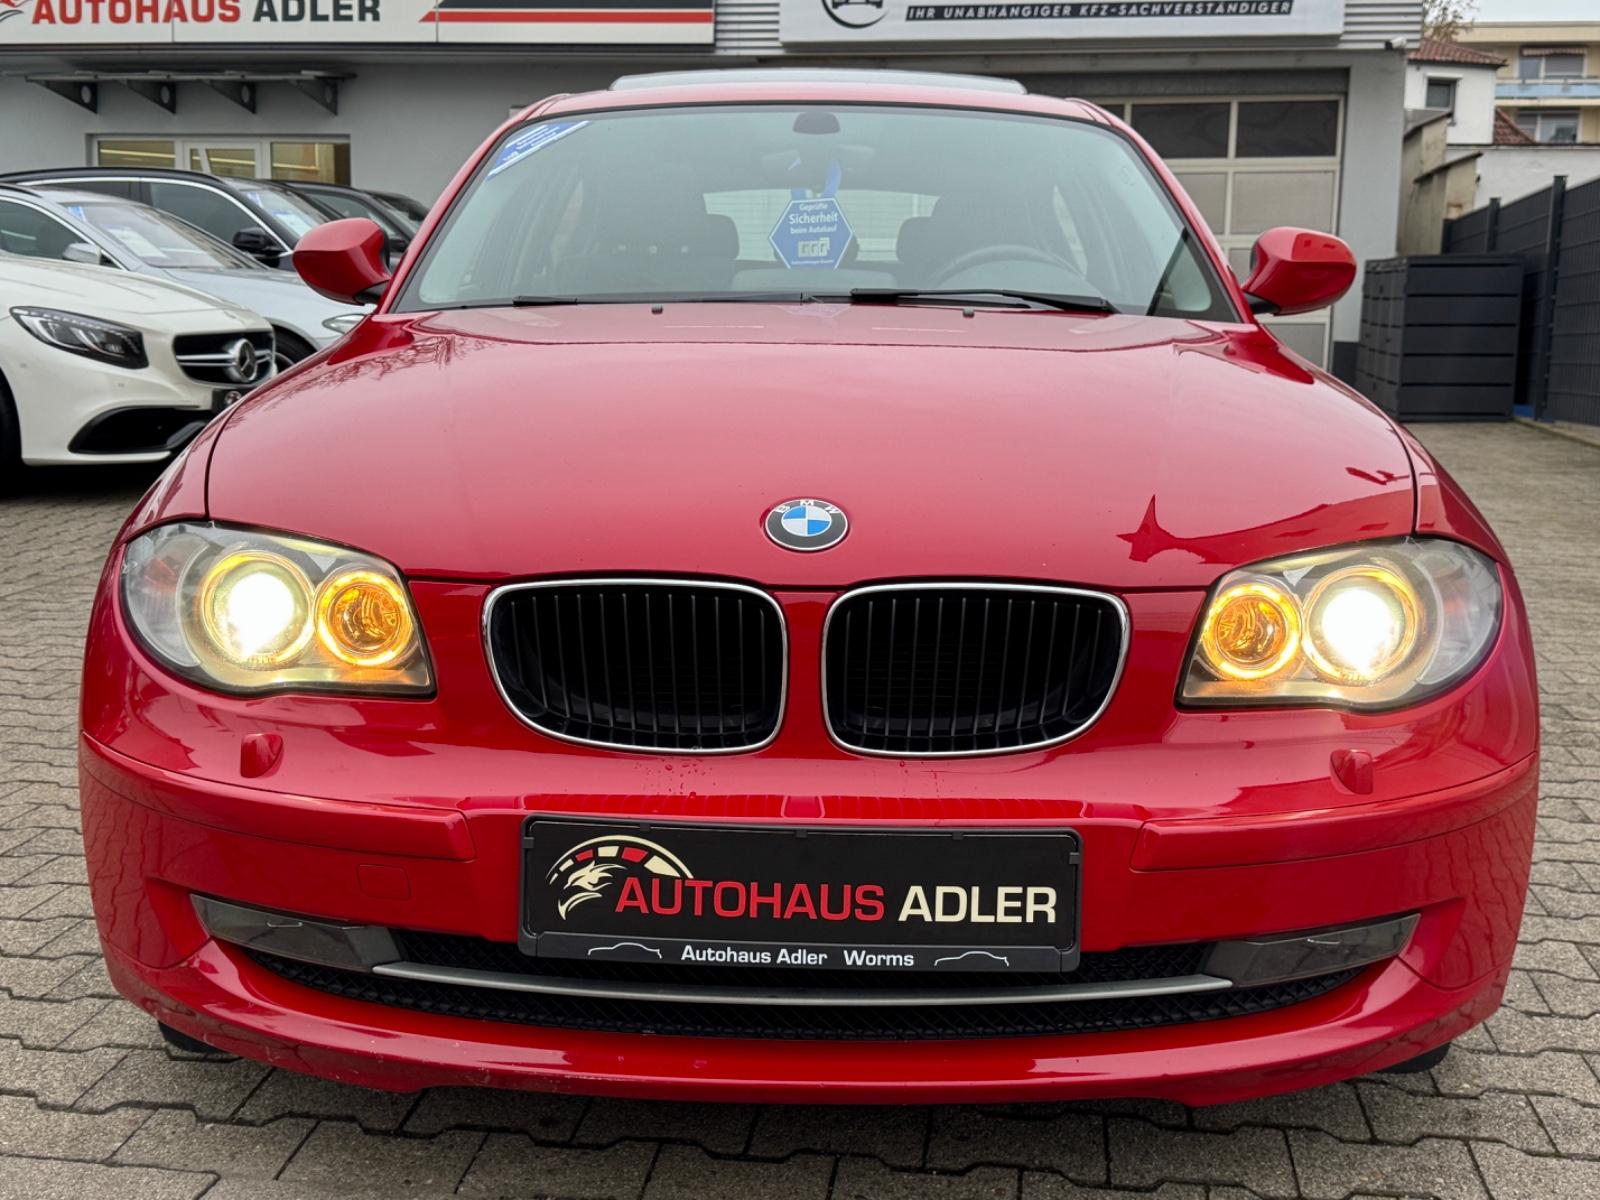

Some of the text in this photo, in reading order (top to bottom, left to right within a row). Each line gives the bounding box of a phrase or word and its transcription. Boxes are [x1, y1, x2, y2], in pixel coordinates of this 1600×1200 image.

[32, 0, 381, 24] AUTOHAUS ADLER
[908, 7, 936, 19] IHR
[789, 211, 838, 224] Sicherheit
[775, 499, 841, 514] BMW
[614, 876, 1057, 923] AUTOHAUS ADLER
[681, 944, 915, 967] Autohaus Adler Worms
